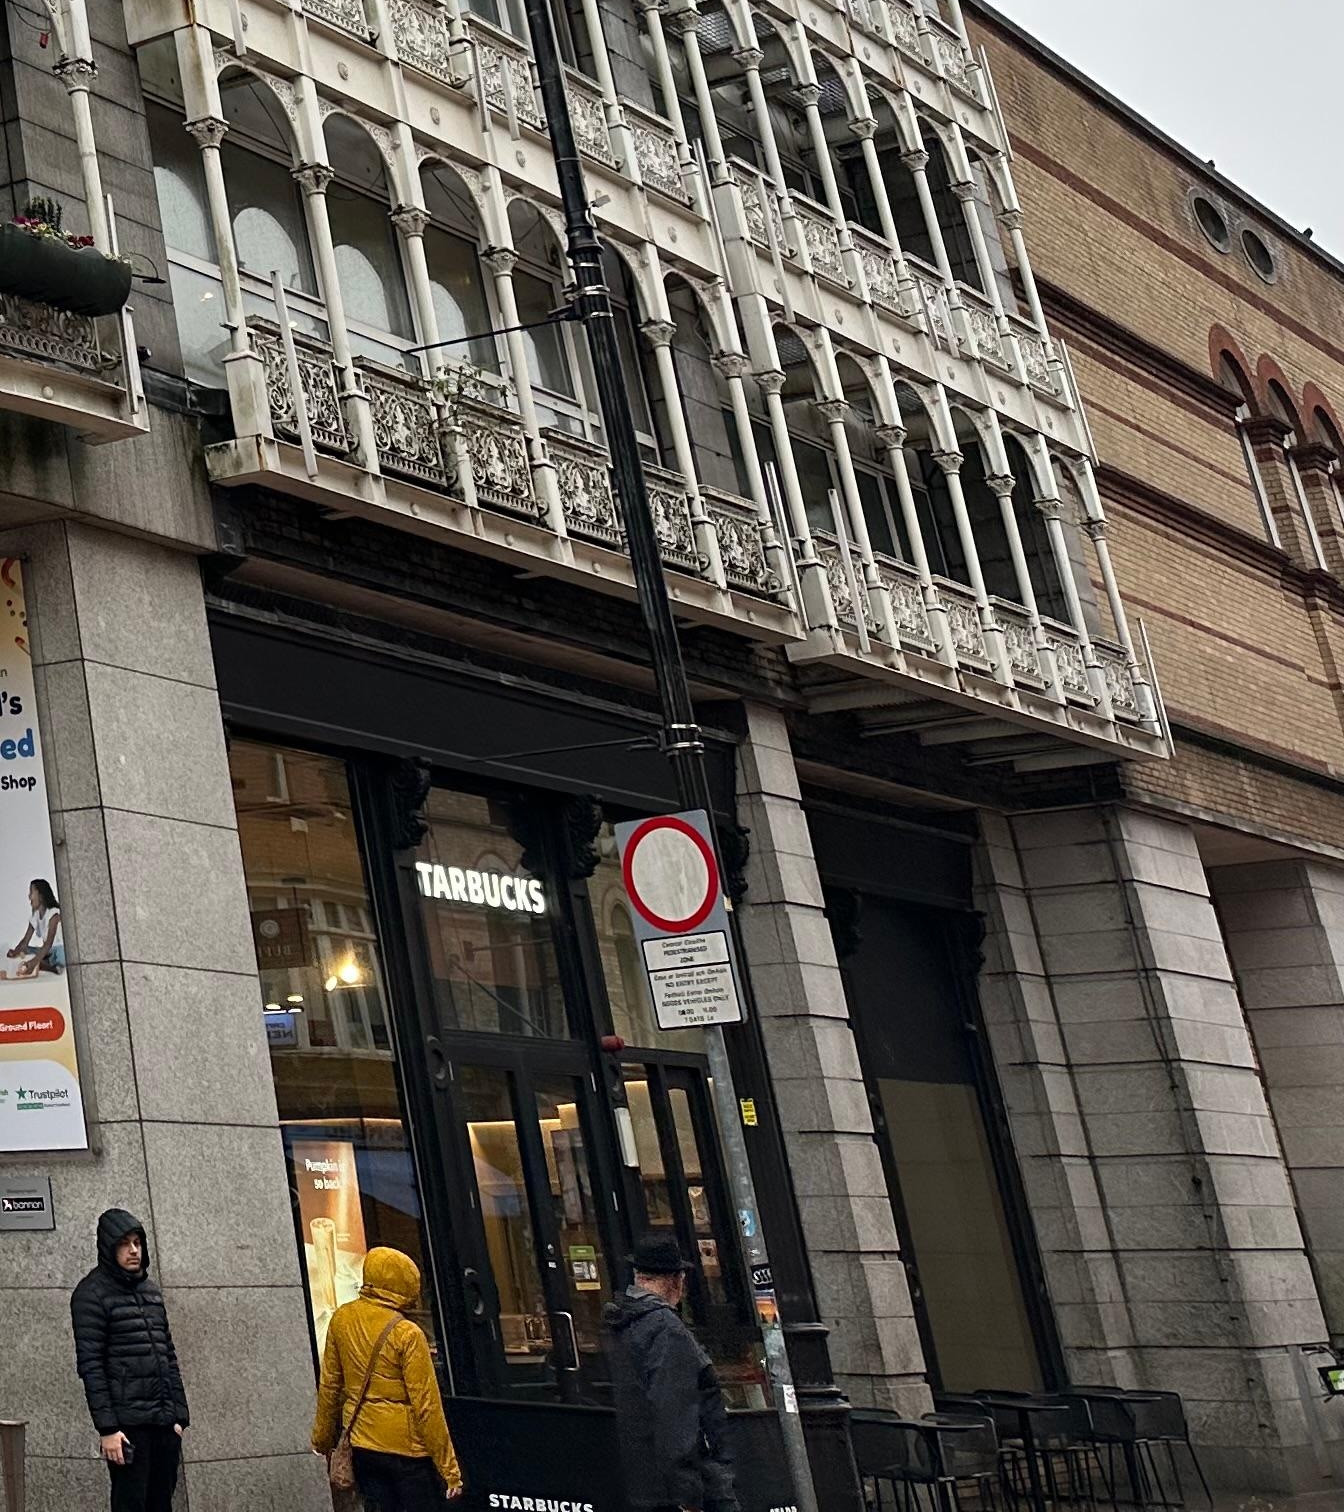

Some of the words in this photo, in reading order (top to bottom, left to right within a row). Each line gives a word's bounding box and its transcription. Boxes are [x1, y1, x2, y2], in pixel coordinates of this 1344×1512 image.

[1, 774, 36, 791] Shop
[415, 862, 545, 914] TARBUCKS
[0, 1022, 27, 1033] Ground
[29, 1020, 53, 1031] Floor!
[28, 1089, 68, 1101] Trustpilot
[12, 1199, 43, 1210] bannon
